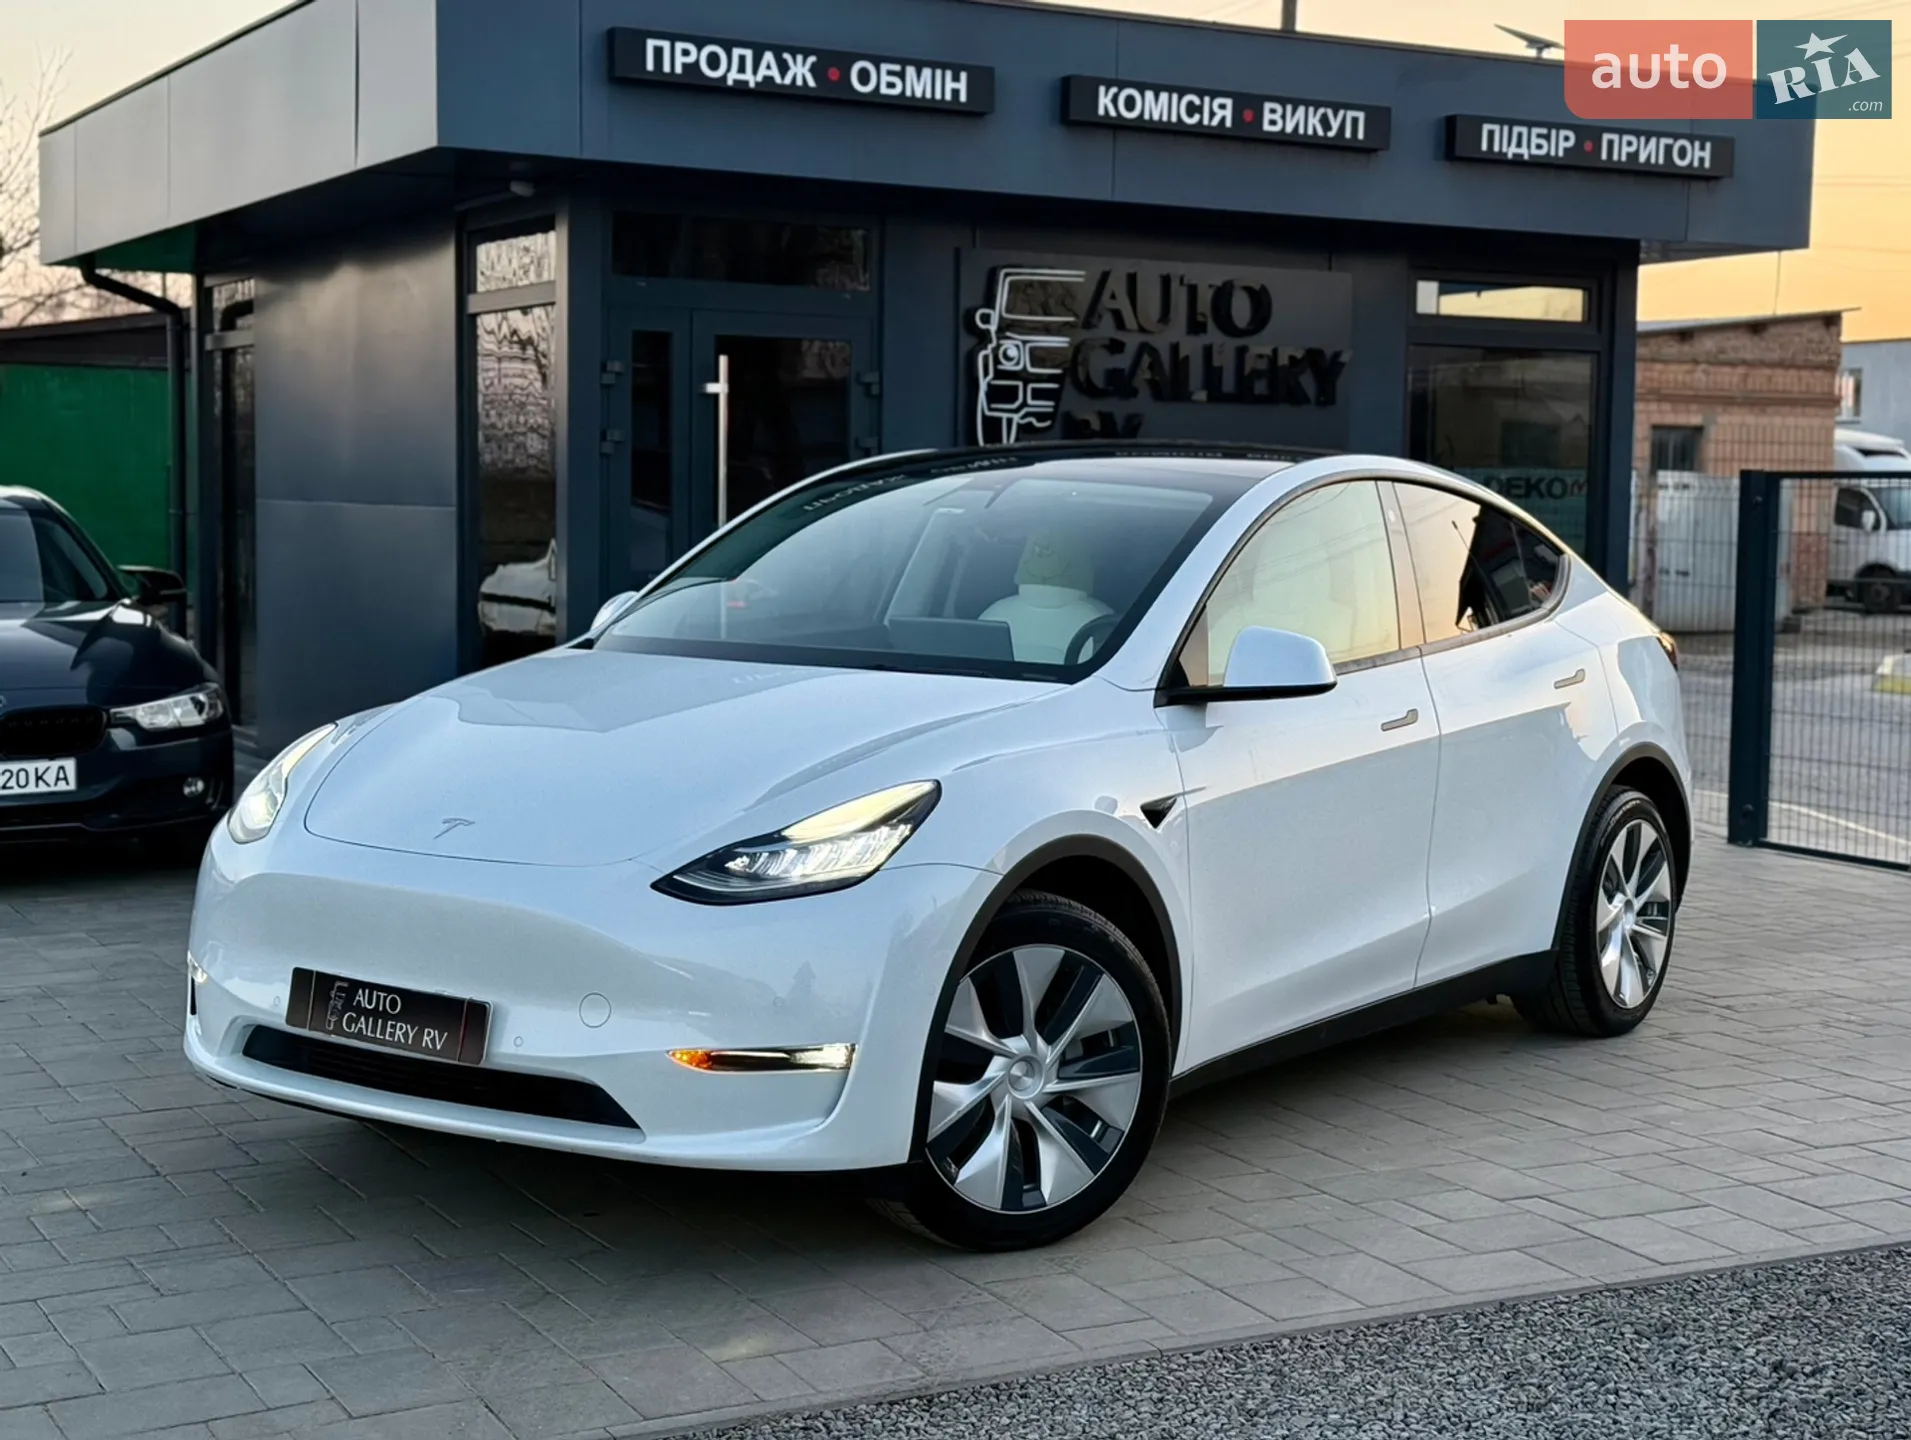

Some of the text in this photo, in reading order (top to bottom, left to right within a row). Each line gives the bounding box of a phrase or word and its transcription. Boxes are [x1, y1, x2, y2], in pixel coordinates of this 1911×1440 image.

[644, 37, 969, 104] ПРОДАЖ ОБМІН
[1096, 84, 1366, 141] КОМІСІЯ ВИКУП
[1480, 122, 1712, 169] ПІДБІР ПРИГОН
[1083, 268, 1273, 336] AUTO
[1072, 338, 1351, 406] GALLERY
[352, 987, 402, 1015] AUTO
[341, 1011, 449, 1052] GALLERY RV
